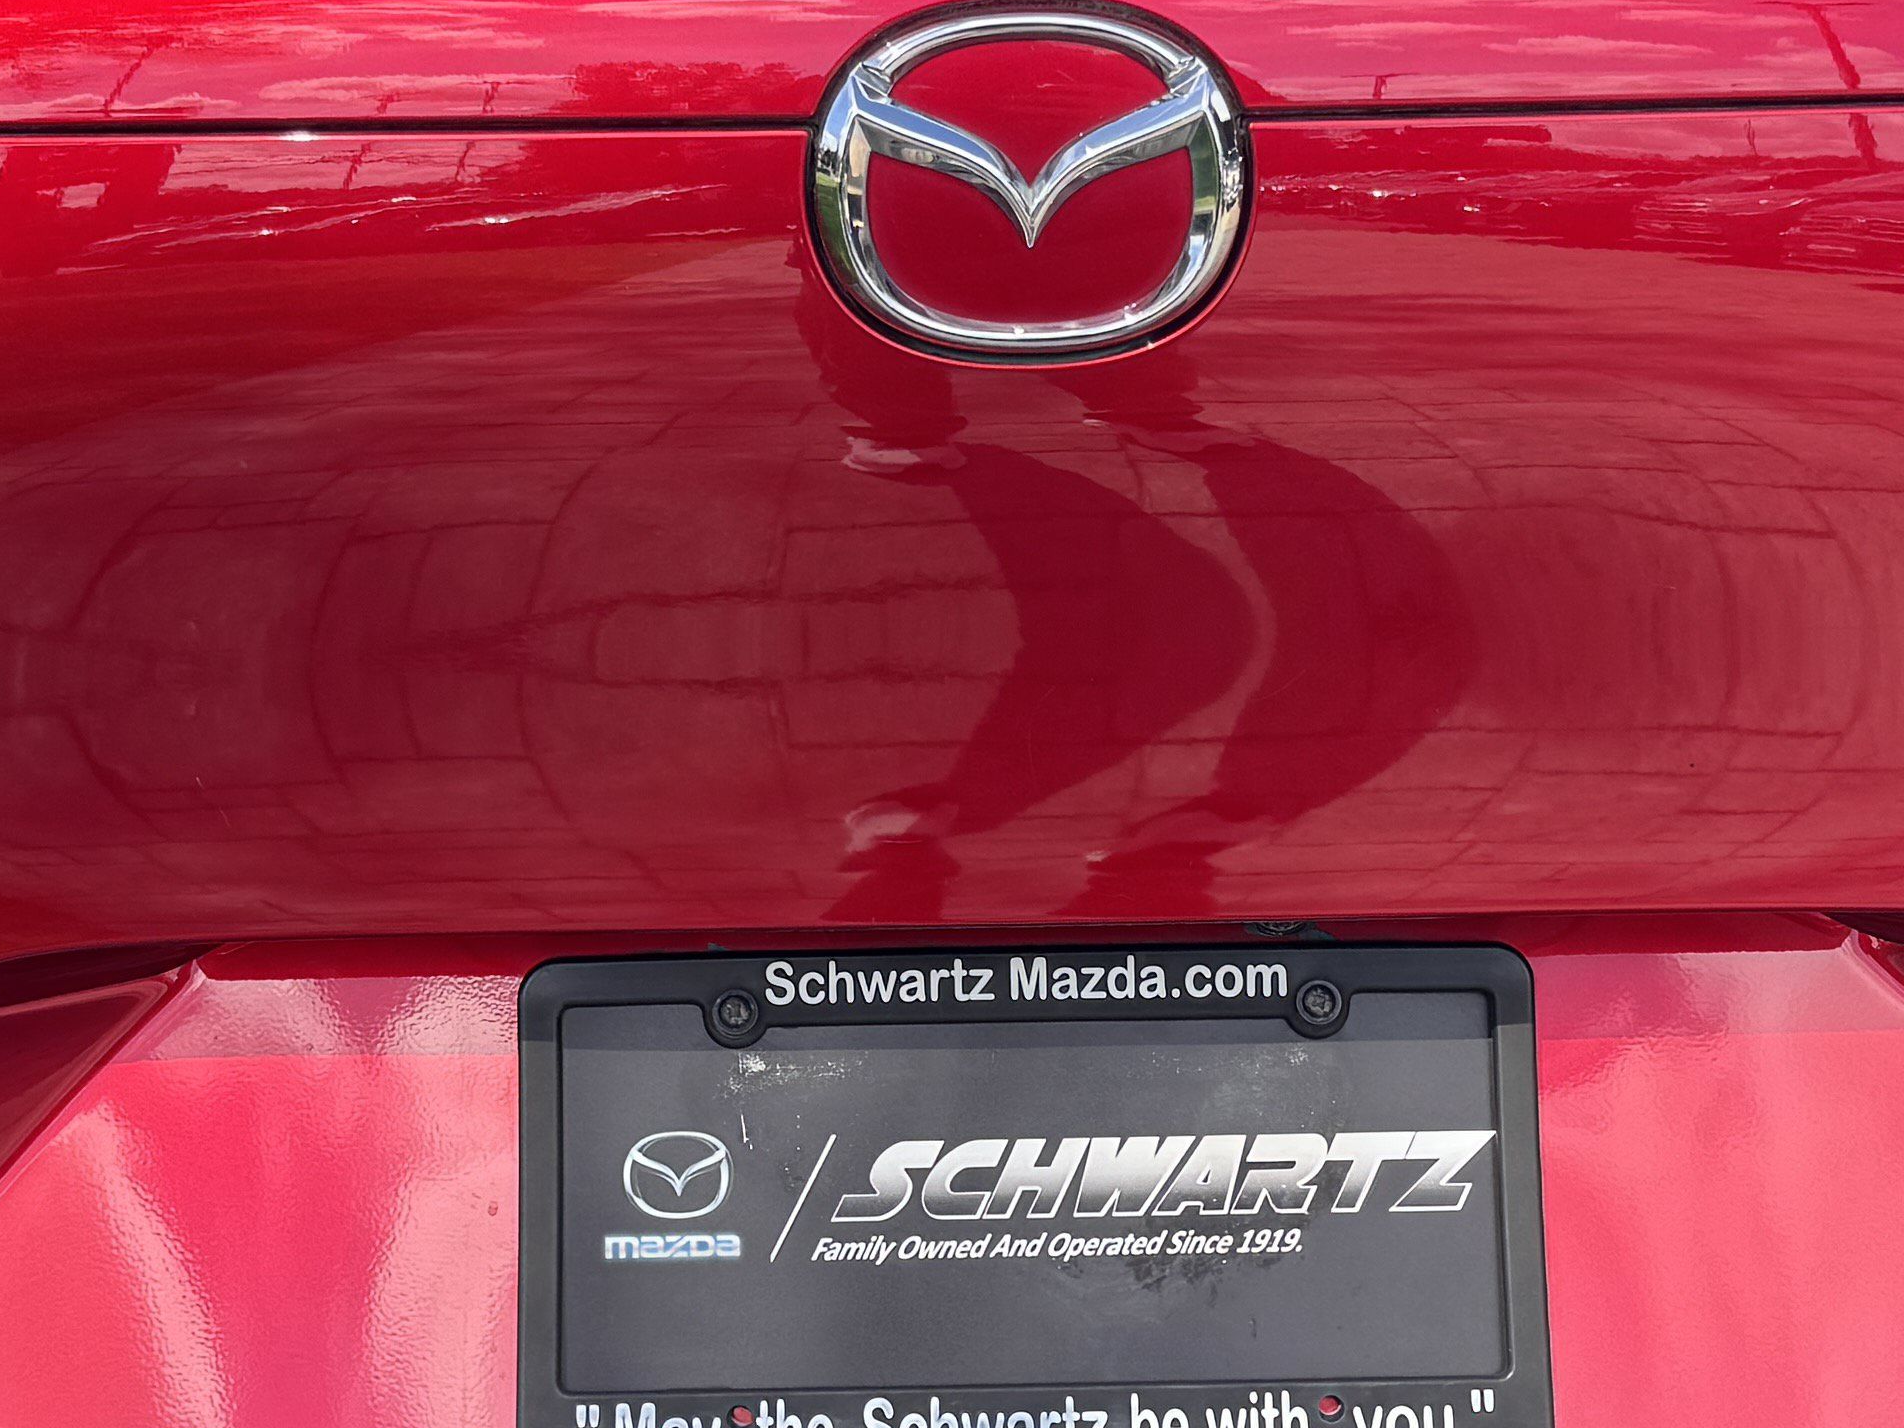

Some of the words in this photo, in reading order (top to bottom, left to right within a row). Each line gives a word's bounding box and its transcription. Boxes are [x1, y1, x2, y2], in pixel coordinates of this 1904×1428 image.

[764, 958, 996, 1006] Schwartz
[1009, 954, 1289, 1002] Mazda.com
[830, 1129, 1498, 1223] SCHWARTZ
[811, 1235, 896, 1266] Family
[897, 1231, 988, 1260] Owned
[989, 1230, 1047, 1258] And
[1047, 1227, 1165, 1262] Operated
[1166, 1228, 1233, 1254] Since
[1236, 1227, 1304, 1254] 1919.
